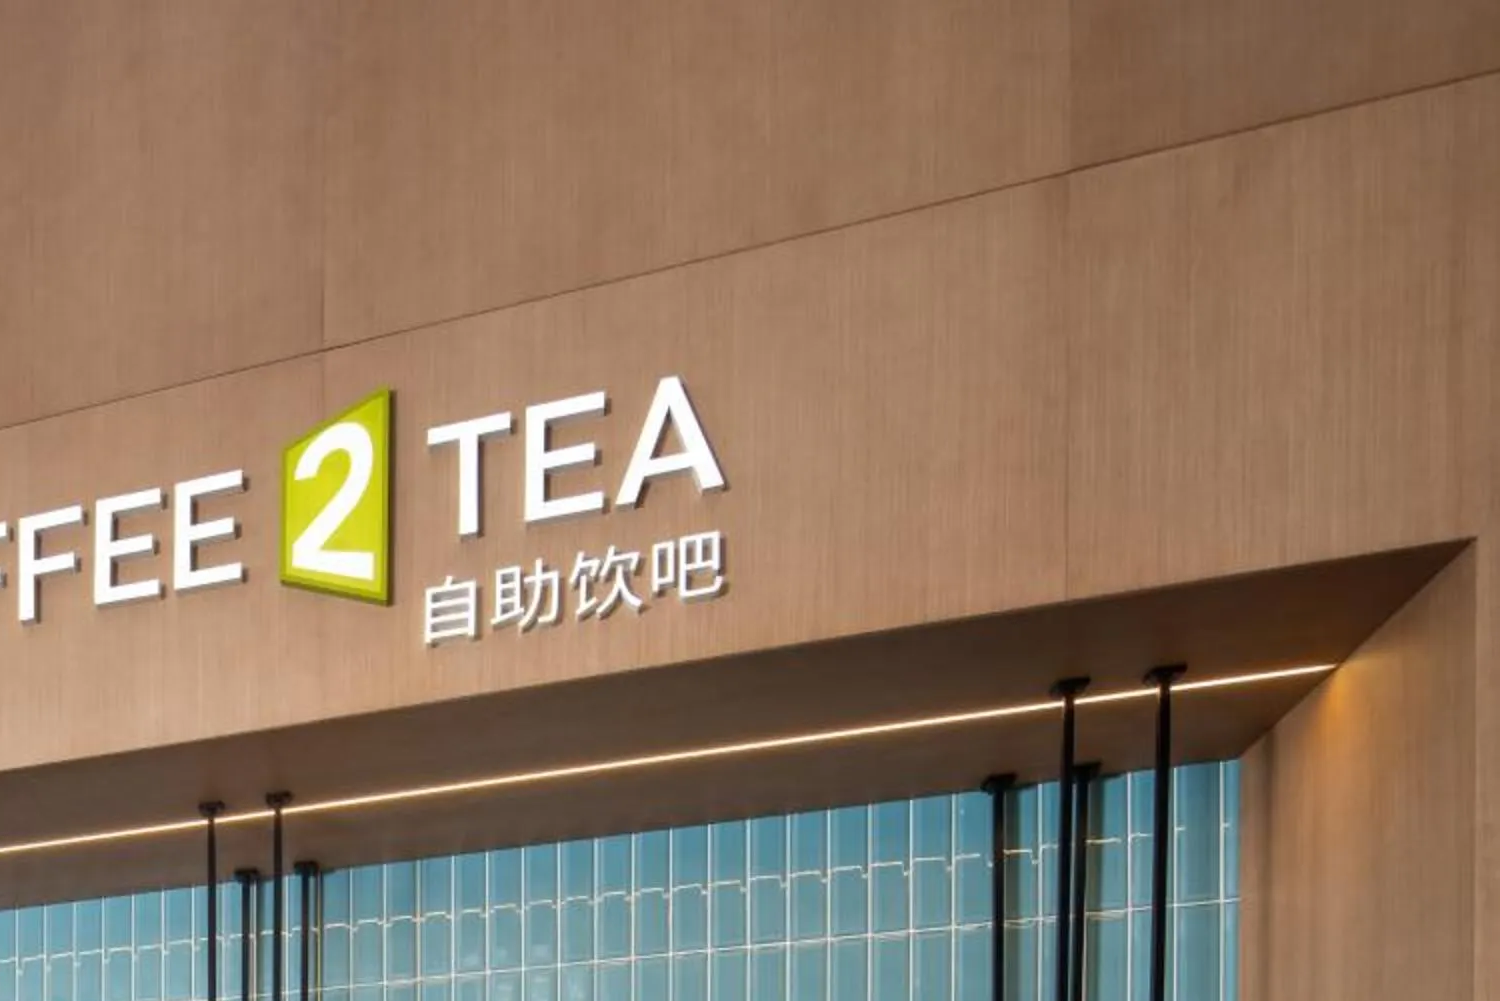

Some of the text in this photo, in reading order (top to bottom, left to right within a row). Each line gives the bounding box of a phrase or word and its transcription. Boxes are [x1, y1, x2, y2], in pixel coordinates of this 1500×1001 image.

[291, 420, 376, 582] 2
[426, 374, 727, 537] TEA
[423, 530, 726, 646] 自助饮吧
